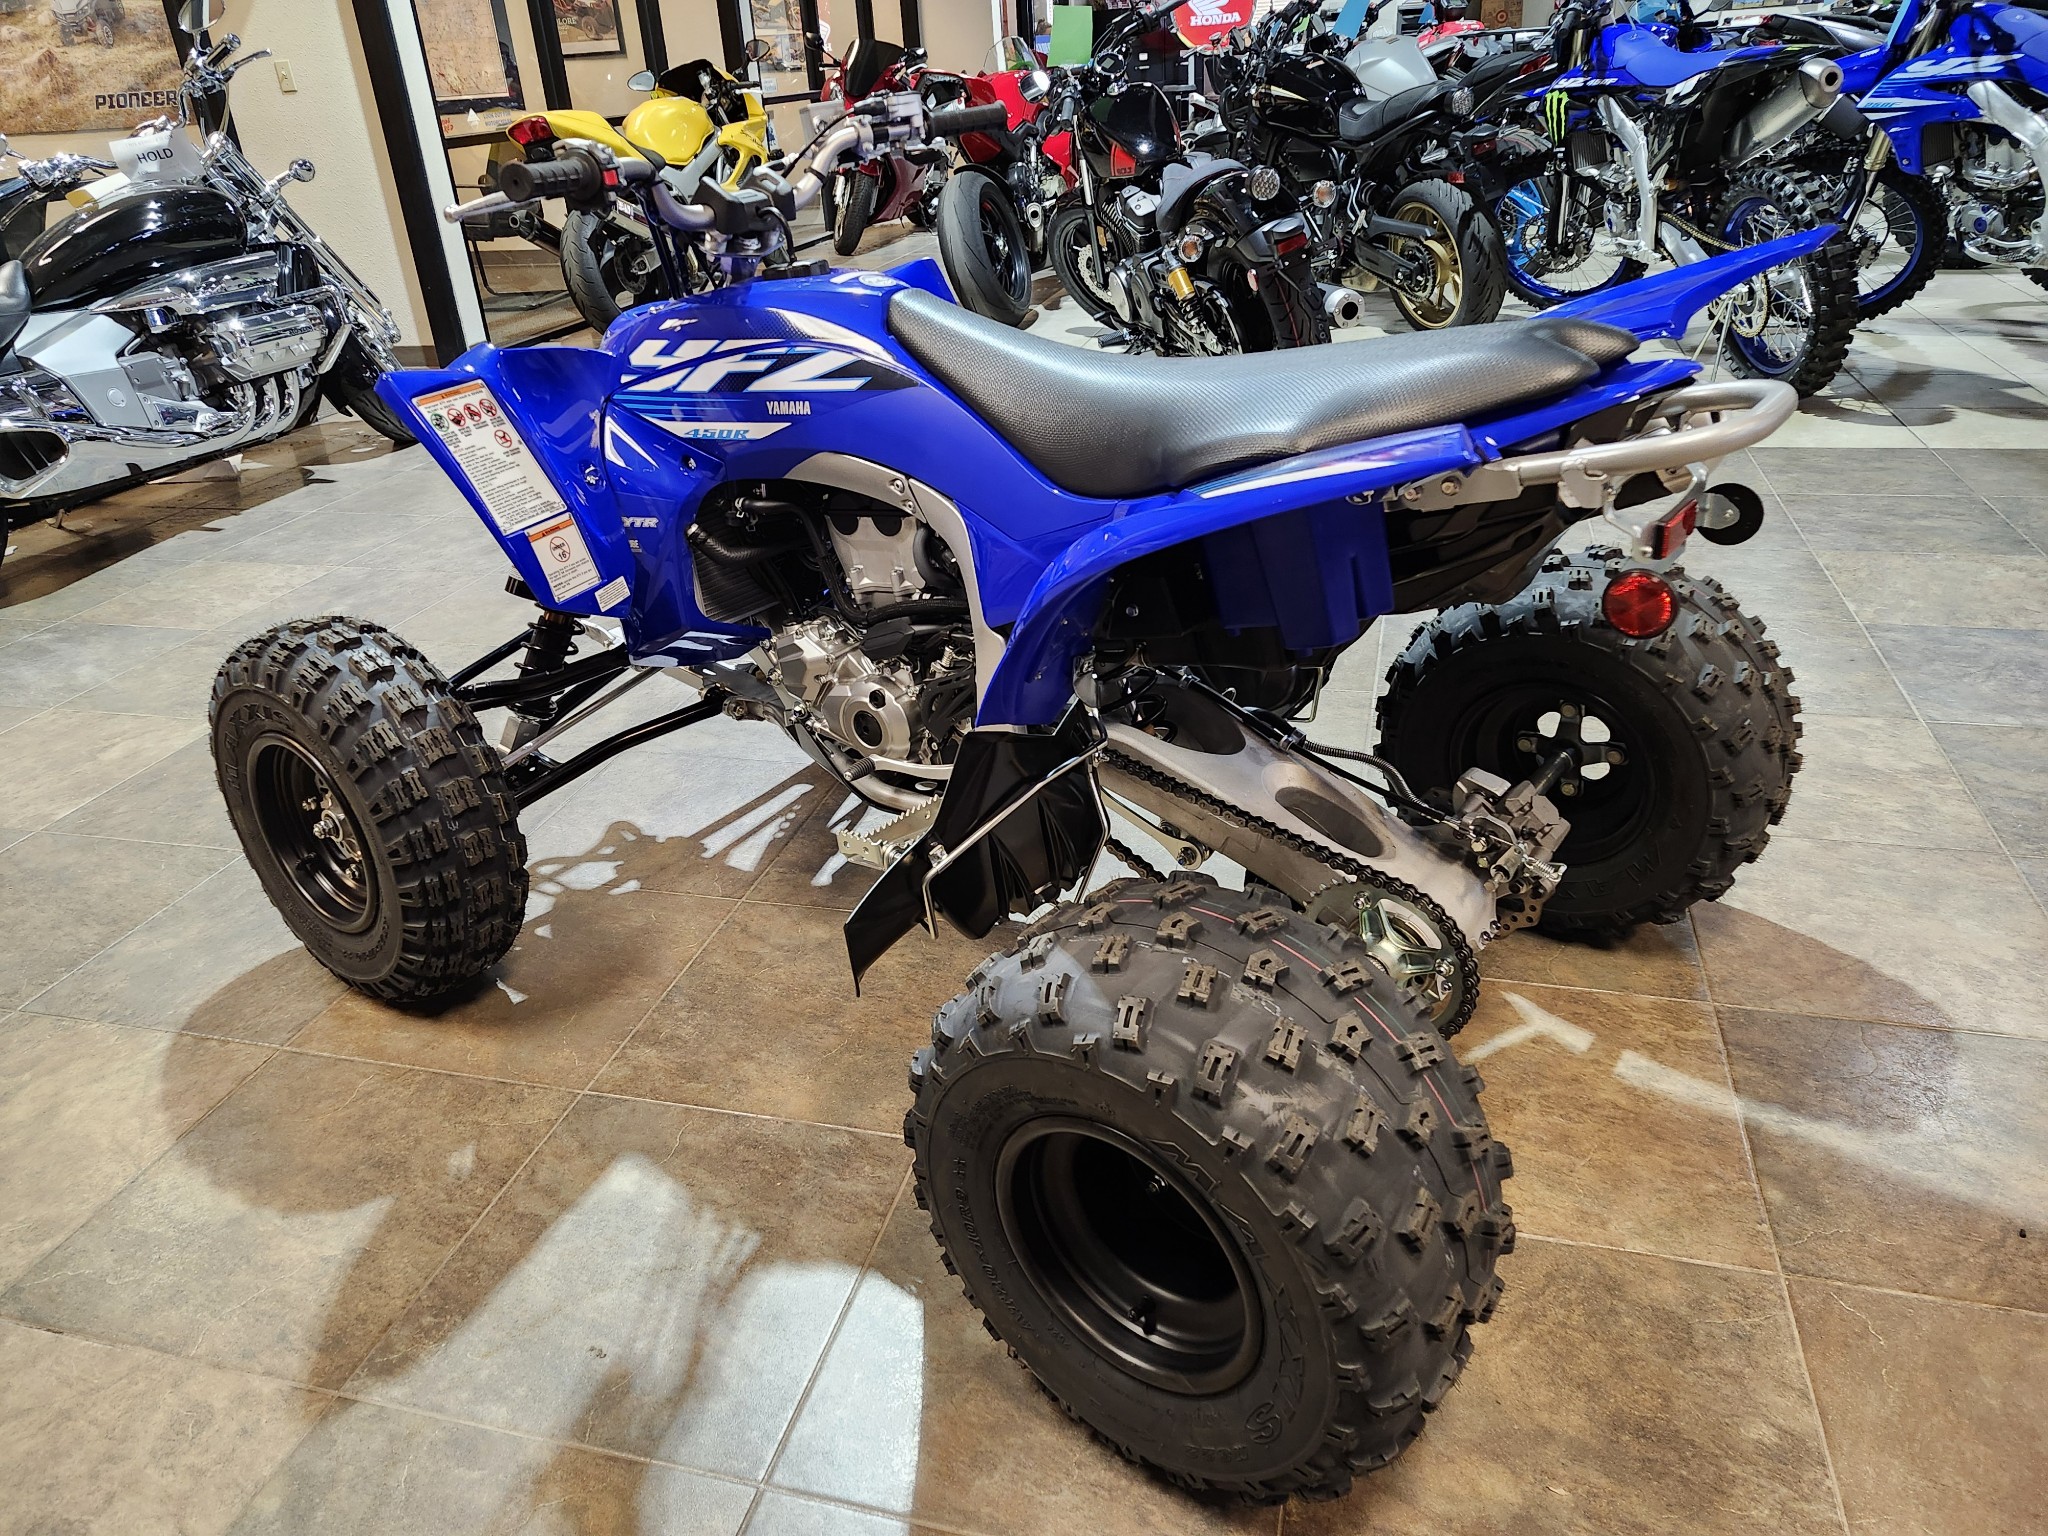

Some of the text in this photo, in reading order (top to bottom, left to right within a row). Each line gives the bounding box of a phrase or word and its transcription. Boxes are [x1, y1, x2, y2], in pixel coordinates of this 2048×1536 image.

[557, 16, 578, 25] LORE
[1189, 12, 1242, 27] HONDA
[95, 90, 179, 110] PIONEER
[136, 148, 174, 164] HOLD
[619, 338, 873, 394] YFZ
[765, 400, 811, 416] YAMAHA
[683, 428, 750, 439] 450R
[558, 550, 567, 561] 16
